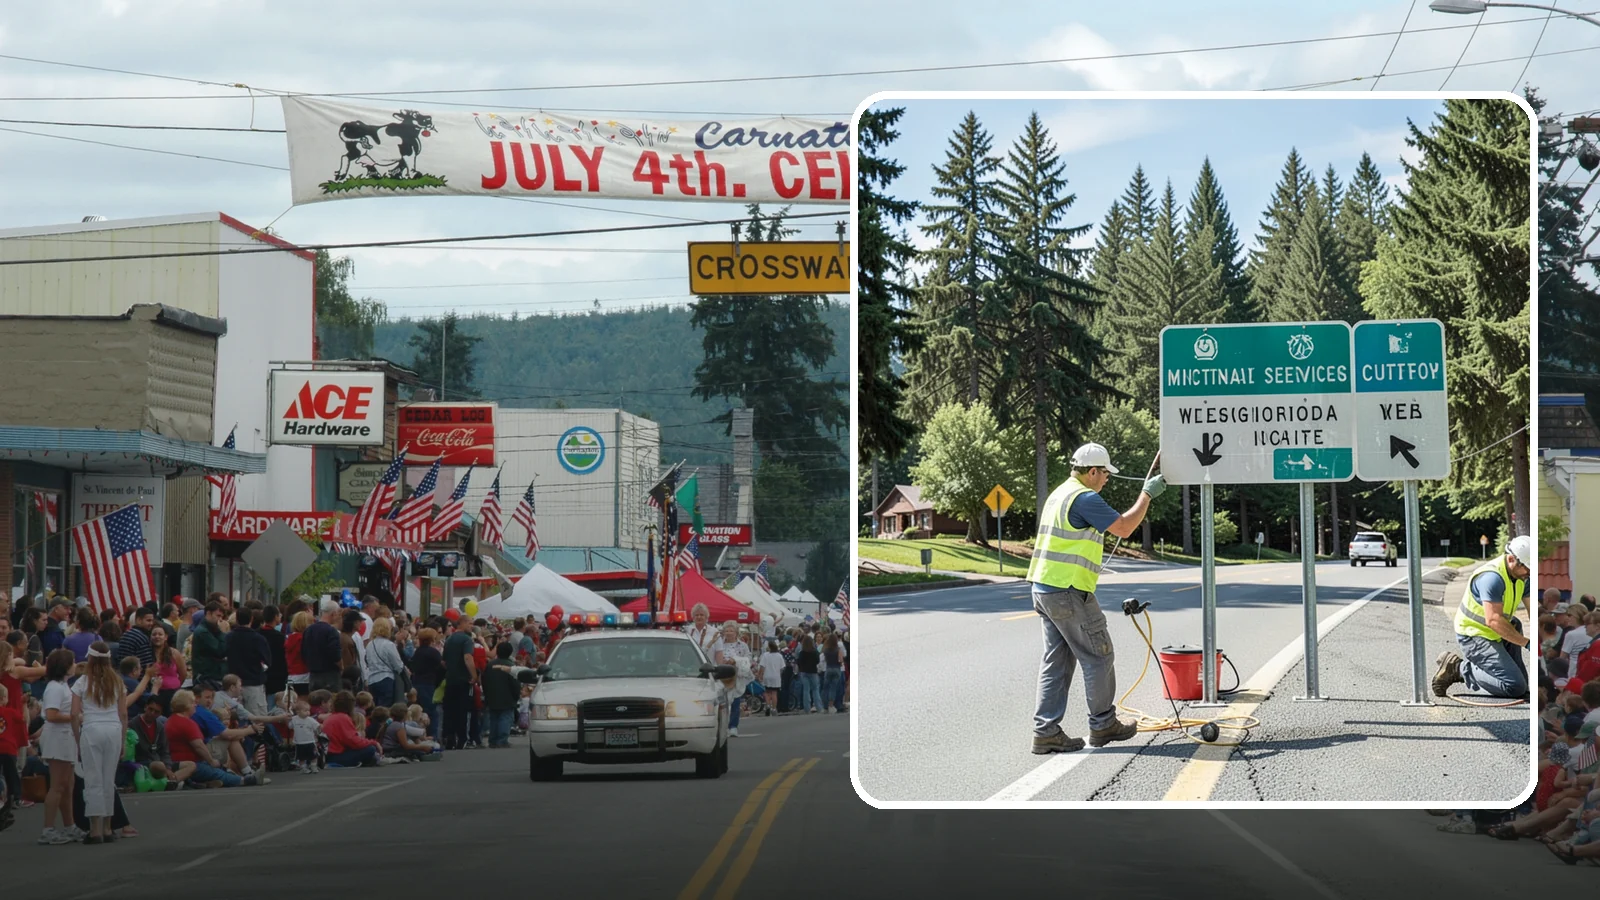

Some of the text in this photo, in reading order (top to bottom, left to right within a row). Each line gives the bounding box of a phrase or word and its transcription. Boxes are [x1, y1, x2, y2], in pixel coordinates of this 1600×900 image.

[481, 141, 605, 193] JULY
[632, 150, 747, 197] 4th.
[697, 253, 850, 280] CROSSWA
[282, 380, 373, 420] ACE
[405, 409, 452, 422] CEDAR
[283, 421, 371, 436] Hardware
[416, 428, 477, 447] Coca-Cola
[83, 485, 155, 495] St. Vincent de Paul
[688, 527, 741, 535] CRNATION
[699, 535, 730, 543] GLASS
